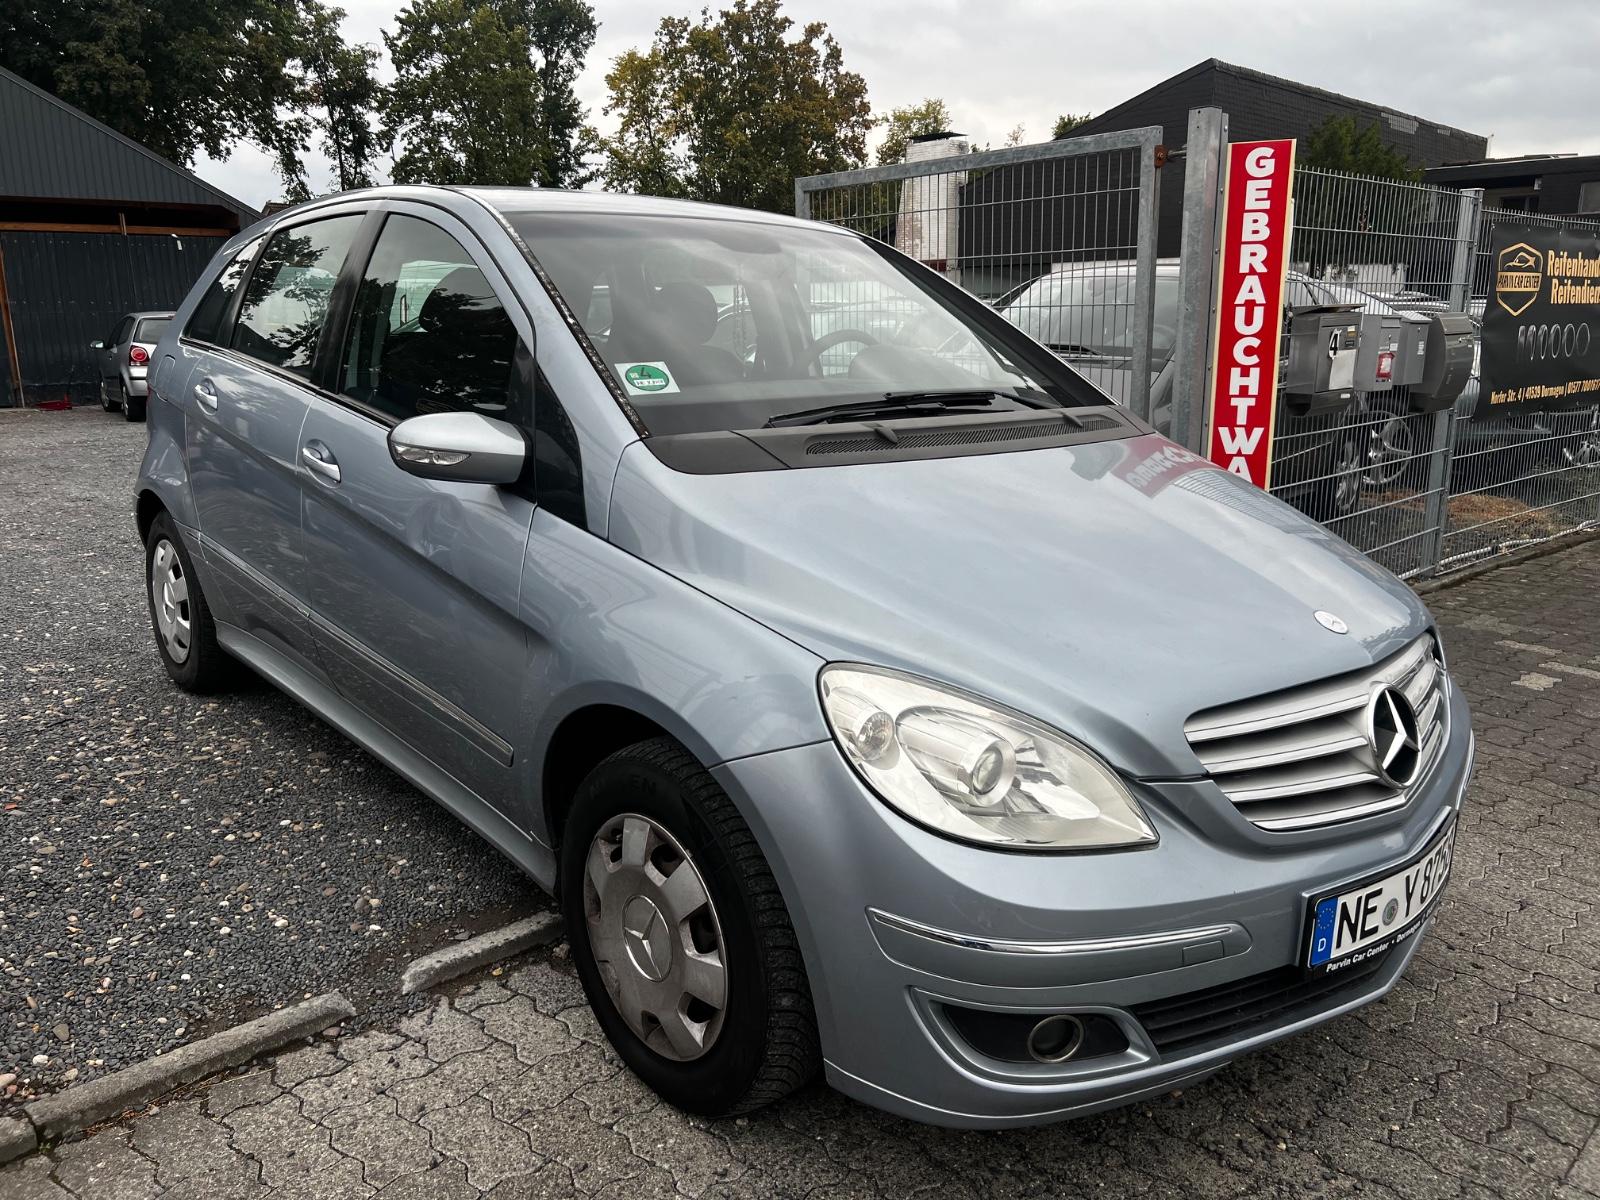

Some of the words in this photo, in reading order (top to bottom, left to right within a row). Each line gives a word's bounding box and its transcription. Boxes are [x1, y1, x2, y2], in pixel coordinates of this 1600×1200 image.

[1218, 147, 1275, 483] GEBRAUCHTWA
[1329, 330, 1340, 357] 4
[640, 366, 652, 379] 4
[1336, 888, 1383, 949] NE
[1405, 868, 1420, 918] Y
[1318, 938, 1326, 952] D
[1326, 958, 1351, 972] Parvin
[1352, 951, 1366, 963] Car
[1366, 942, 1389, 957] Center
